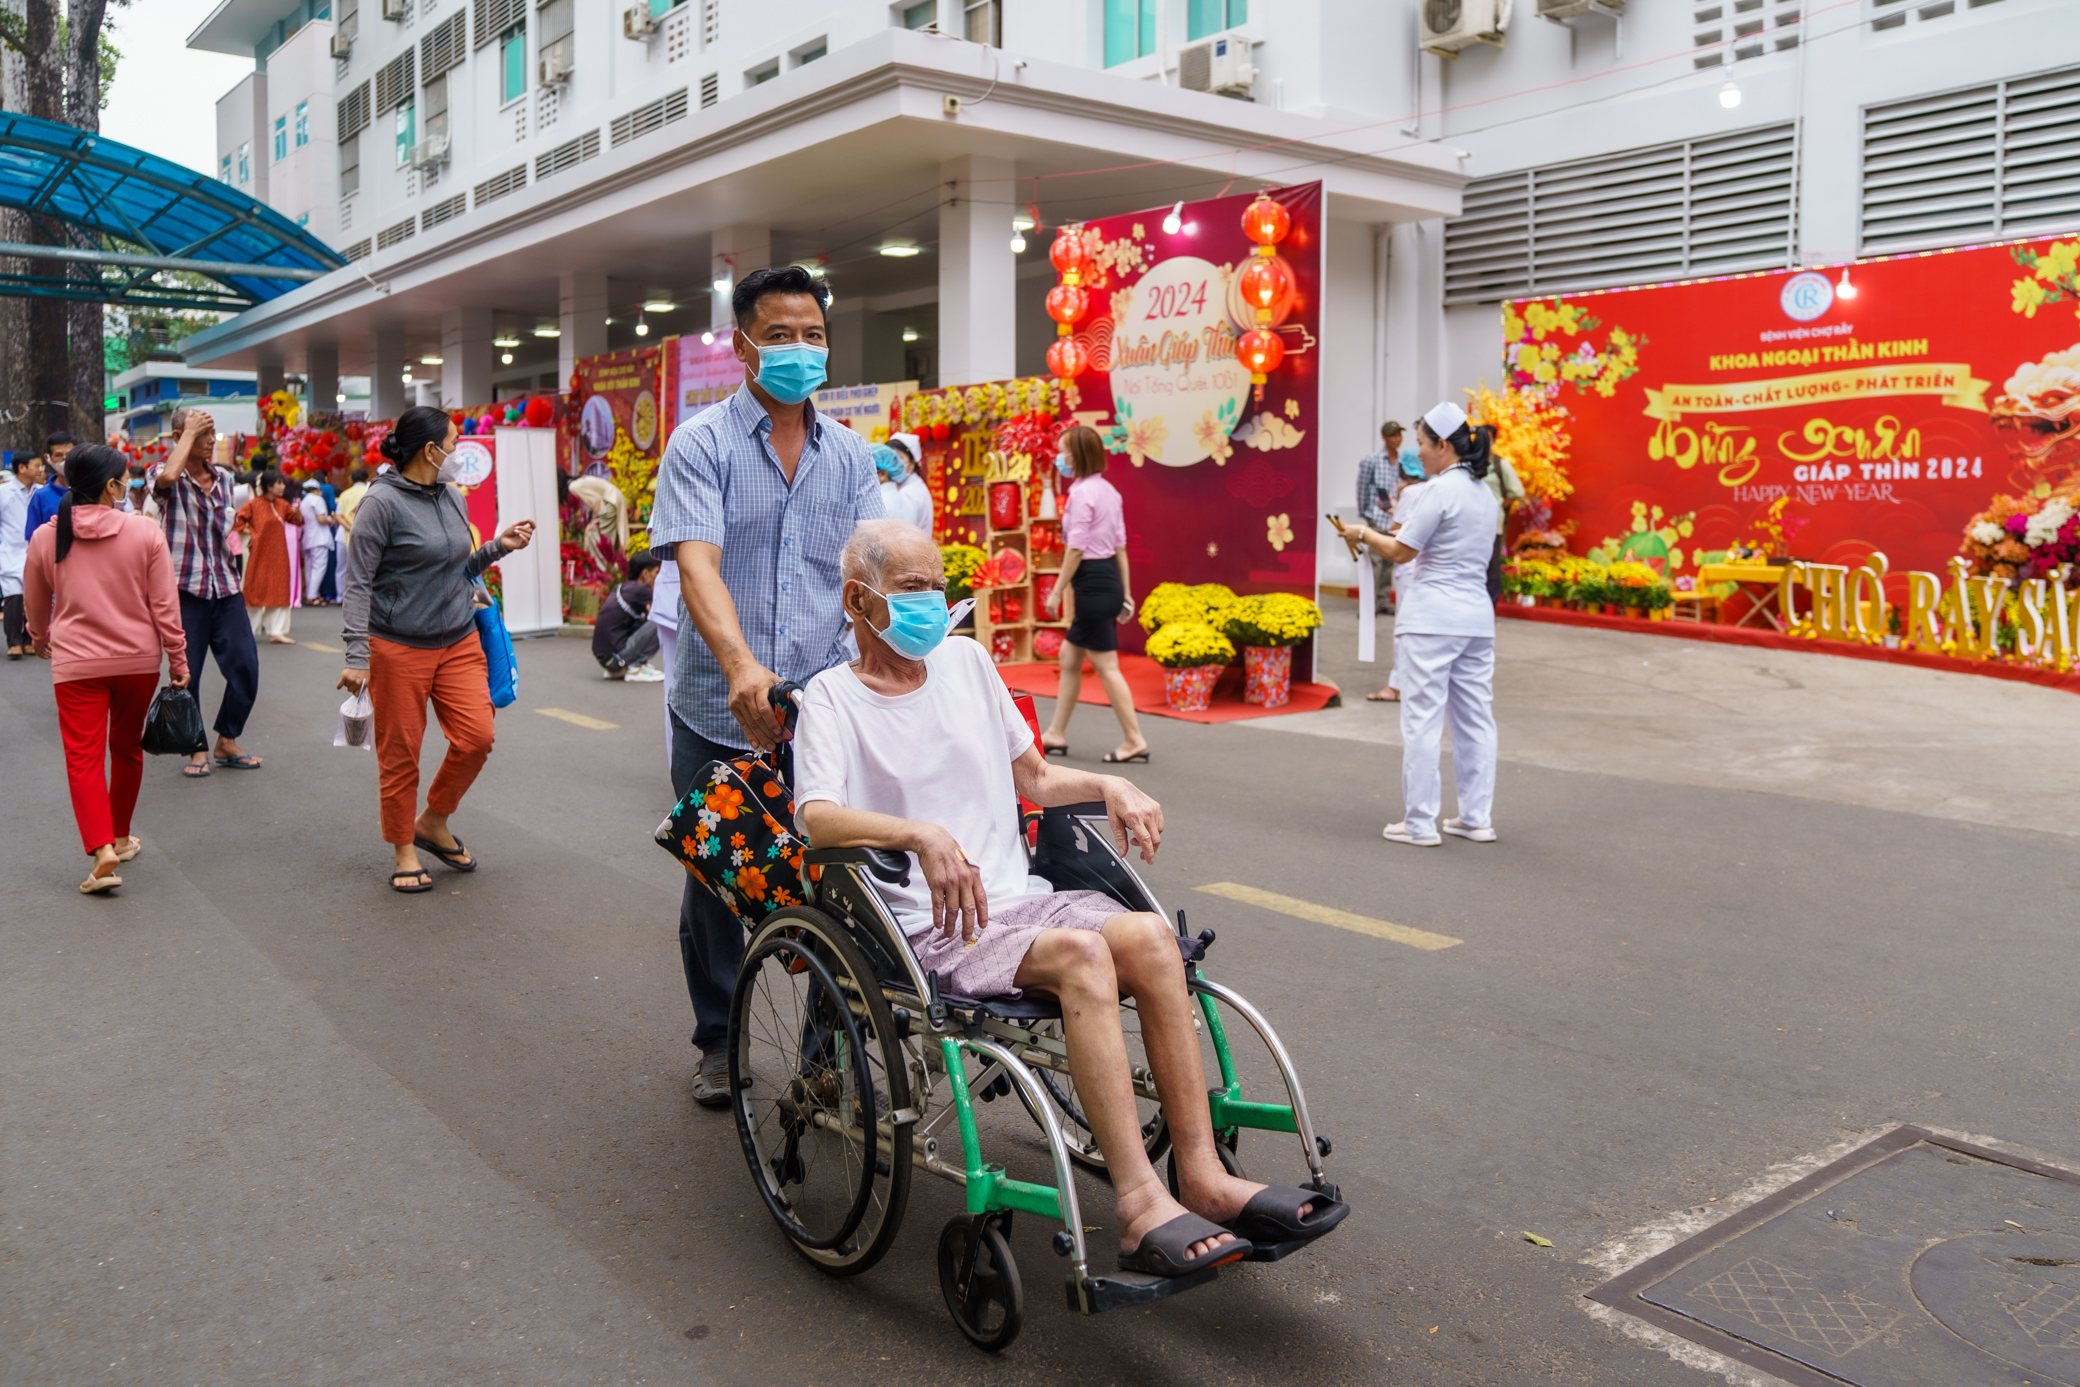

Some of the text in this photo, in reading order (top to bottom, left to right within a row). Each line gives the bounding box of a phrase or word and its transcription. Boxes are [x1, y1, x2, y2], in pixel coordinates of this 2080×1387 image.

[1144, 280, 1207, 320] 2024
[1811, 325, 1833, 339] CHỢ
[1106, 335, 1157, 370] Xuân
[1158, 330, 1199, 374] Giáp
[1709, 338, 1928, 371] KHOA NGOẠI THẦN KINH
[1144, 375, 1174, 396] Tổng
[1671, 395, 1691, 407] AN
[1856, 373, 1899, 391] PHÁT
[1903, 369, 1955, 389] TRIỂN
[983, 449, 1032, 482] 2024
[1793, 456, 1983, 482] GIÁP THÌN 2024
[1734, 482, 1901, 505] HAPPY NEW YEAR
[1778, 552, 1889, 646] CHỢ
[2016, 562, 2080, 672] SẮ
